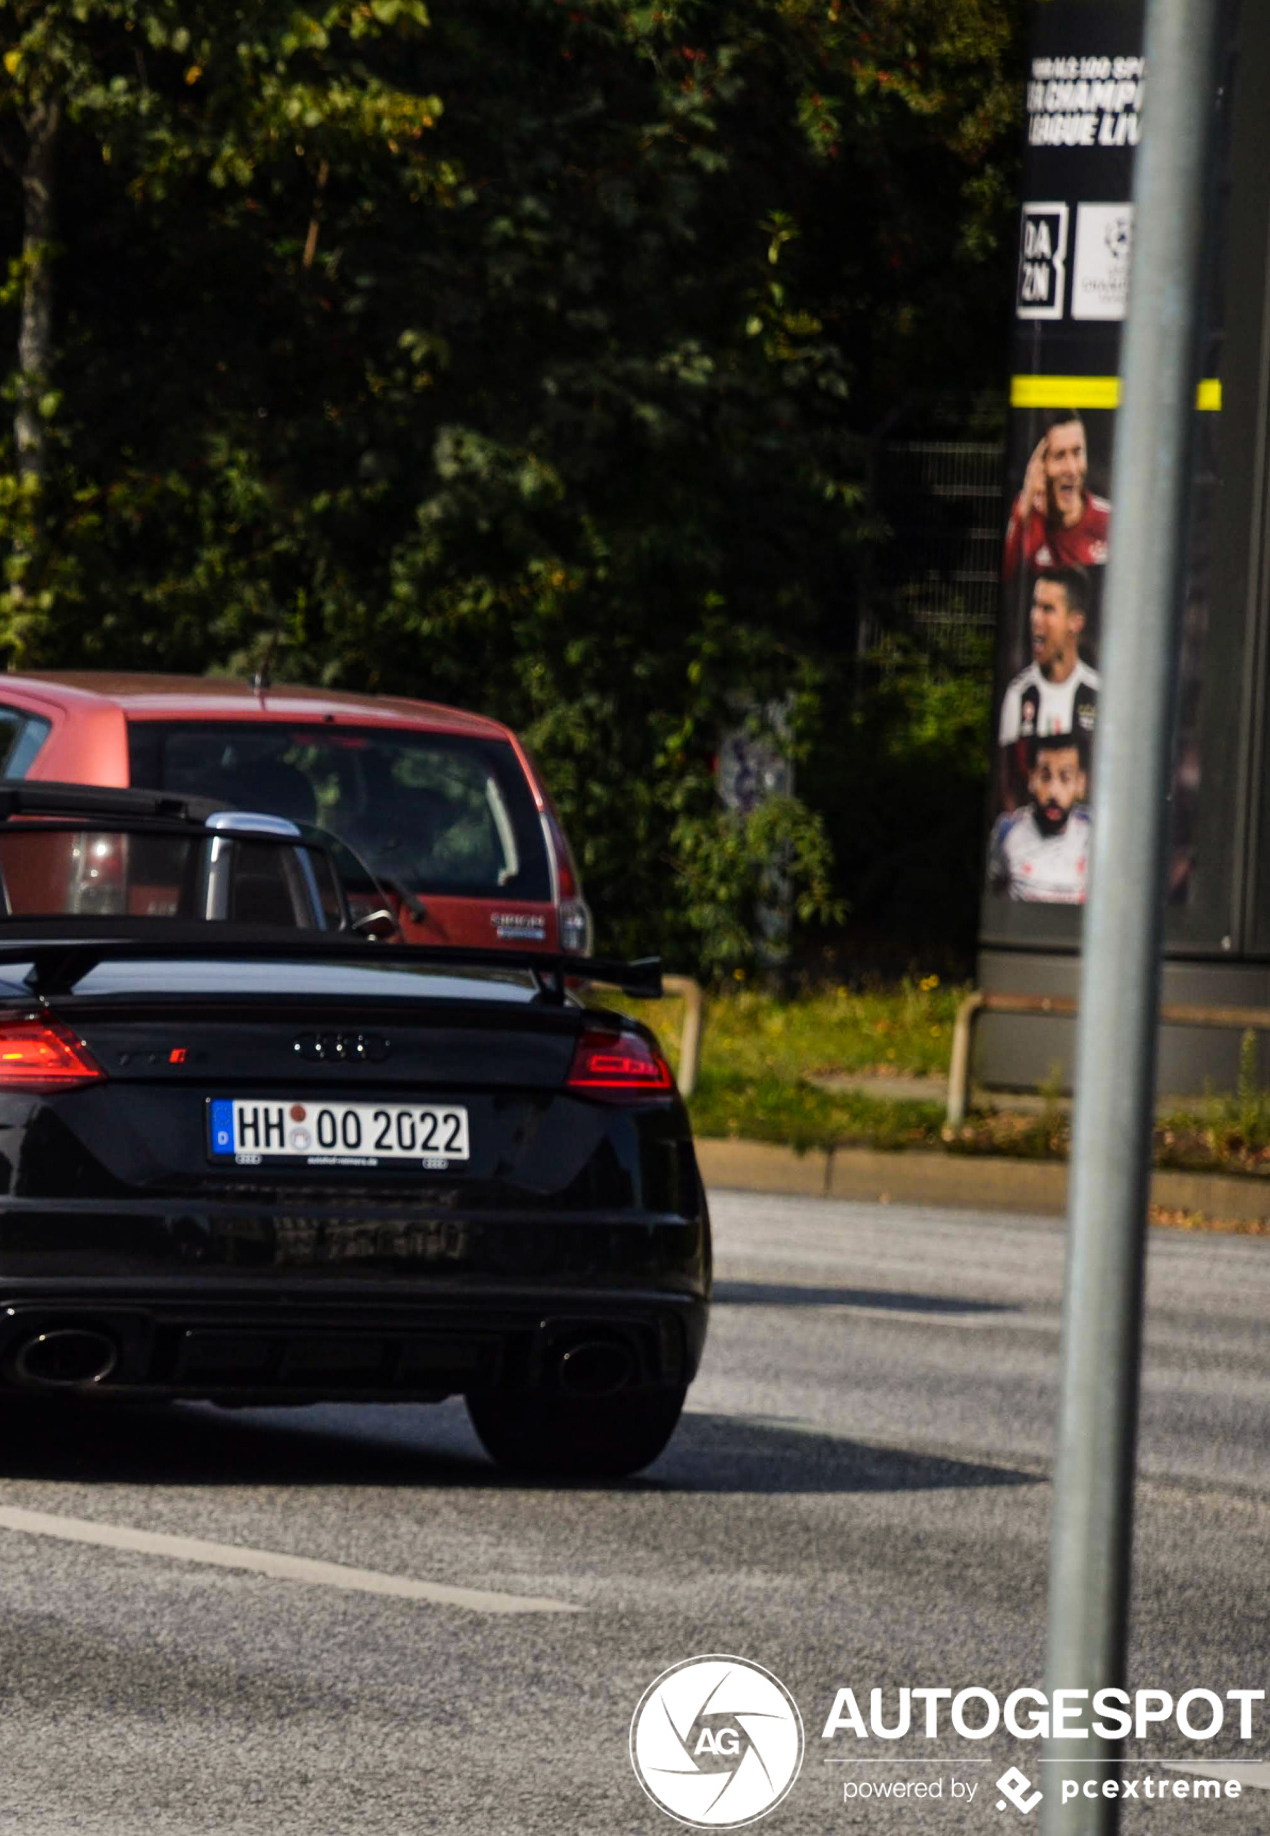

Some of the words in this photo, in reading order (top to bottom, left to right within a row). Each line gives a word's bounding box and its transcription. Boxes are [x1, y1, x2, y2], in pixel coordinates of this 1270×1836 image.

[1098, 112, 1142, 146] LIV
[218, 1131, 229, 1145] D
[238, 1107, 285, 1148] HH
[316, 1109, 362, 1149] OO
[373, 1111, 463, 1153] 2022
